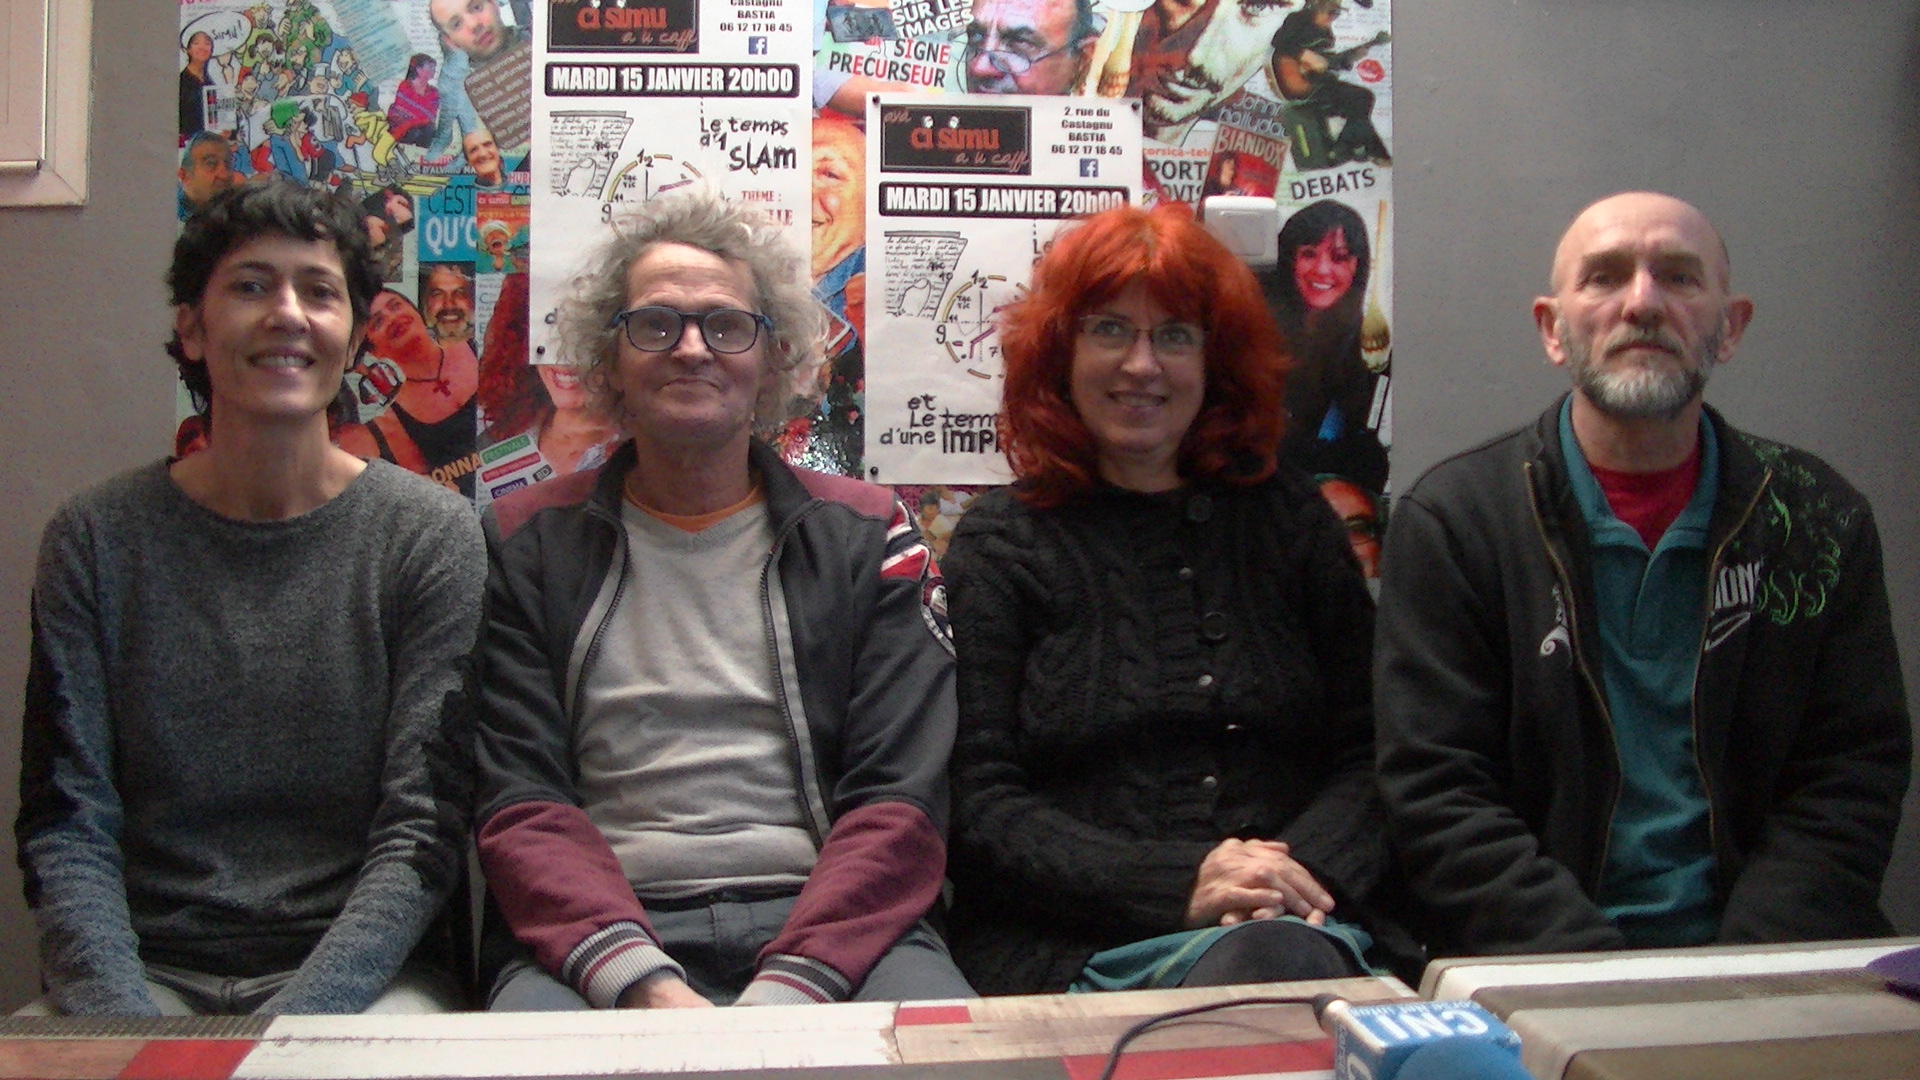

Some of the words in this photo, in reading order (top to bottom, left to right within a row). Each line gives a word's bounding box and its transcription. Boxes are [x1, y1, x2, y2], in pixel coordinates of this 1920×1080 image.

[737, 10, 776, 19] BASTIA
[892, 2, 934, 26] SUR
[895, 8, 975, 39] IMAGES
[720, 22, 734, 32] 06
[738, 23, 749, 32] 12
[752, 23, 762, 32] 17
[779, 23, 793, 32] 45
[894, 38, 951, 65] SIGNE
[553, 66, 616, 91] MARDI
[621, 66, 643, 91] 15
[646, 67, 724, 91] JANVIER
[728, 68, 793, 92] 20h00
[829, 50, 946, 88] PRECURSEUR
[1075, 107, 1094, 116] rue
[1096, 107, 1110, 117] du
[700, 116, 720, 133] Le
[728, 116, 789, 136] temps
[1061, 119, 1113, 131] Castagnu
[1068, 132, 1106, 142] BASTIA
[1051, 144, 1066, 154] 06
[1068, 145, 1080, 154] 12
[1082, 145, 1093, 155] 17
[1109, 146, 1123, 156] 45
[1291, 167, 1376, 200] DEBATS
[886, 186, 949, 211] MARDI
[954, 187, 977, 211] 15
[981, 188, 1056, 213] JANVIER
[908, 393, 937, 411] et
[910, 410, 936, 429] Le
[939, 407, 999, 429] tem
[880, 428, 936, 445] d'une
[427, 452, 483, 485] ONNA
